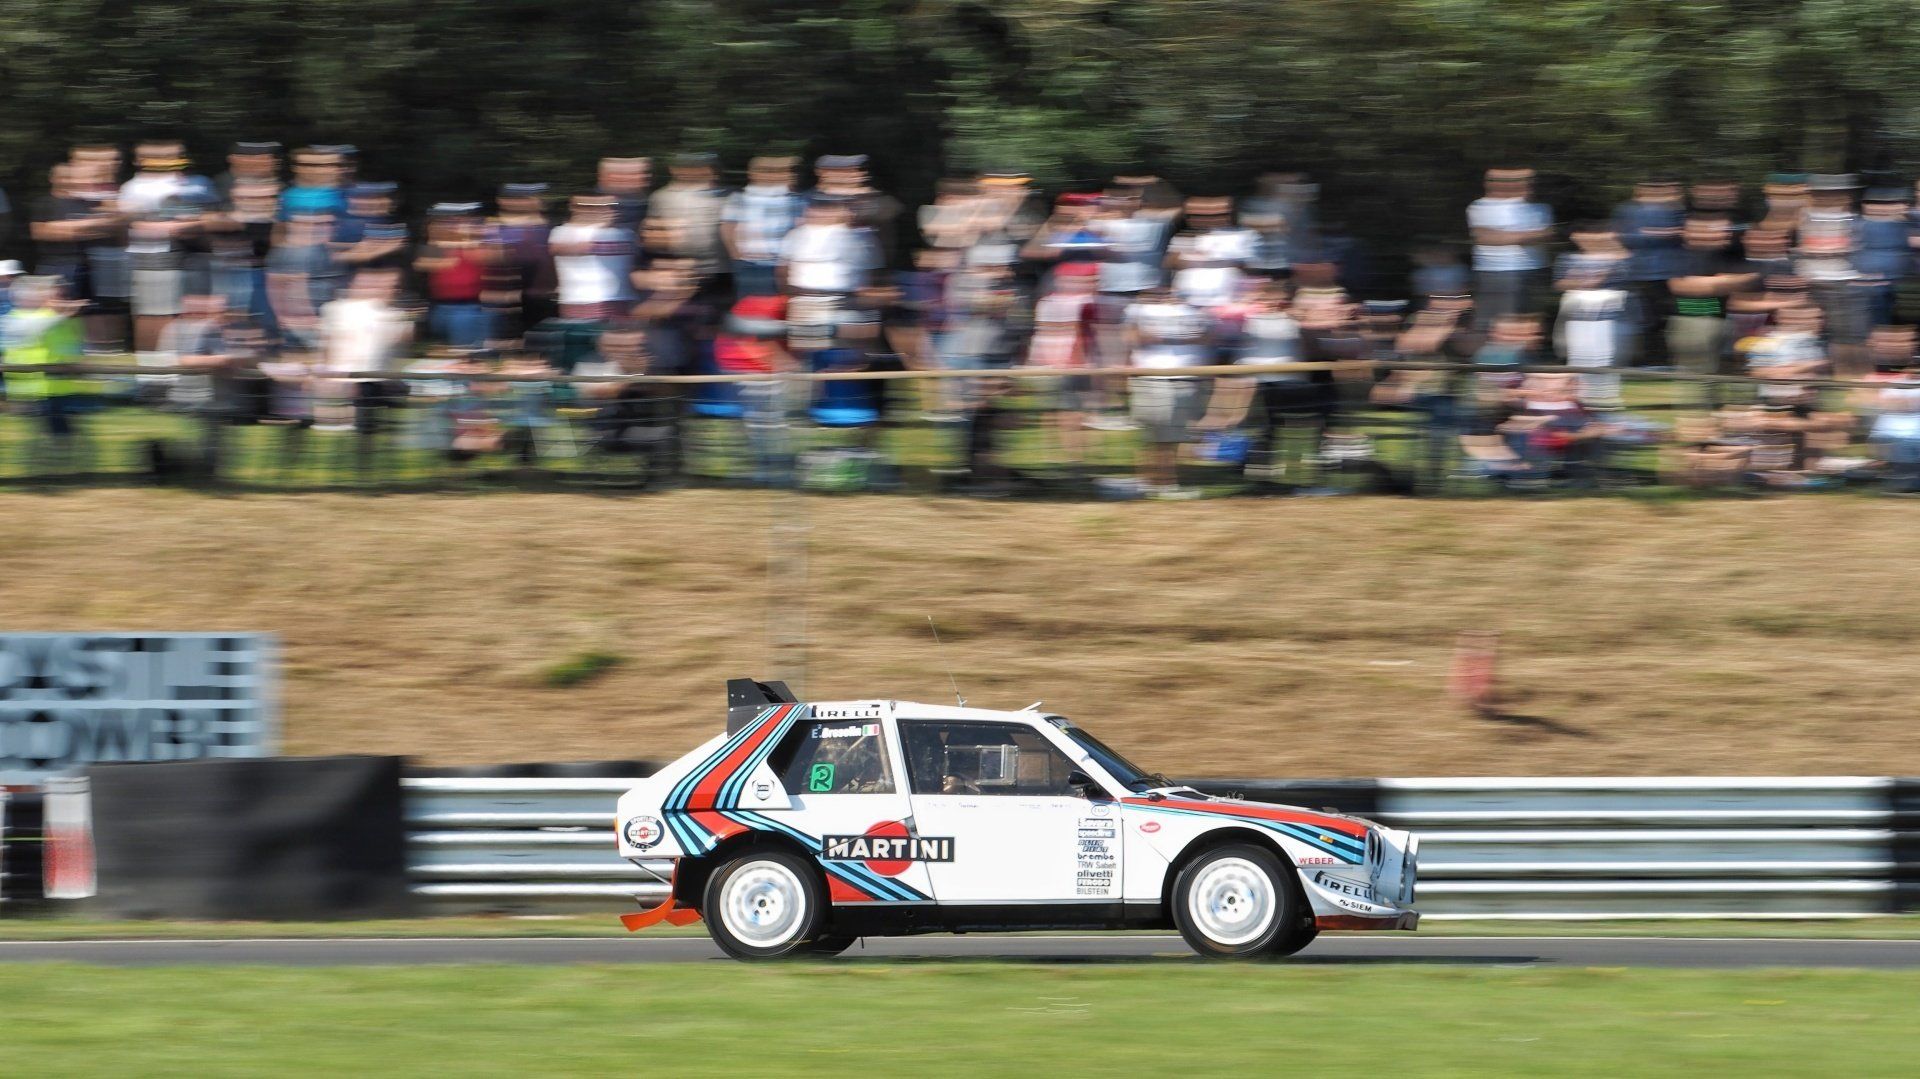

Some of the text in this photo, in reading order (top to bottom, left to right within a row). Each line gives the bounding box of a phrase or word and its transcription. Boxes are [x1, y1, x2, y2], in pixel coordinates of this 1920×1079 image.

[827, 837, 949, 860] MARTINI
[1299, 857, 1334, 865] WEBER
[1077, 869, 1113, 878] olivetti
